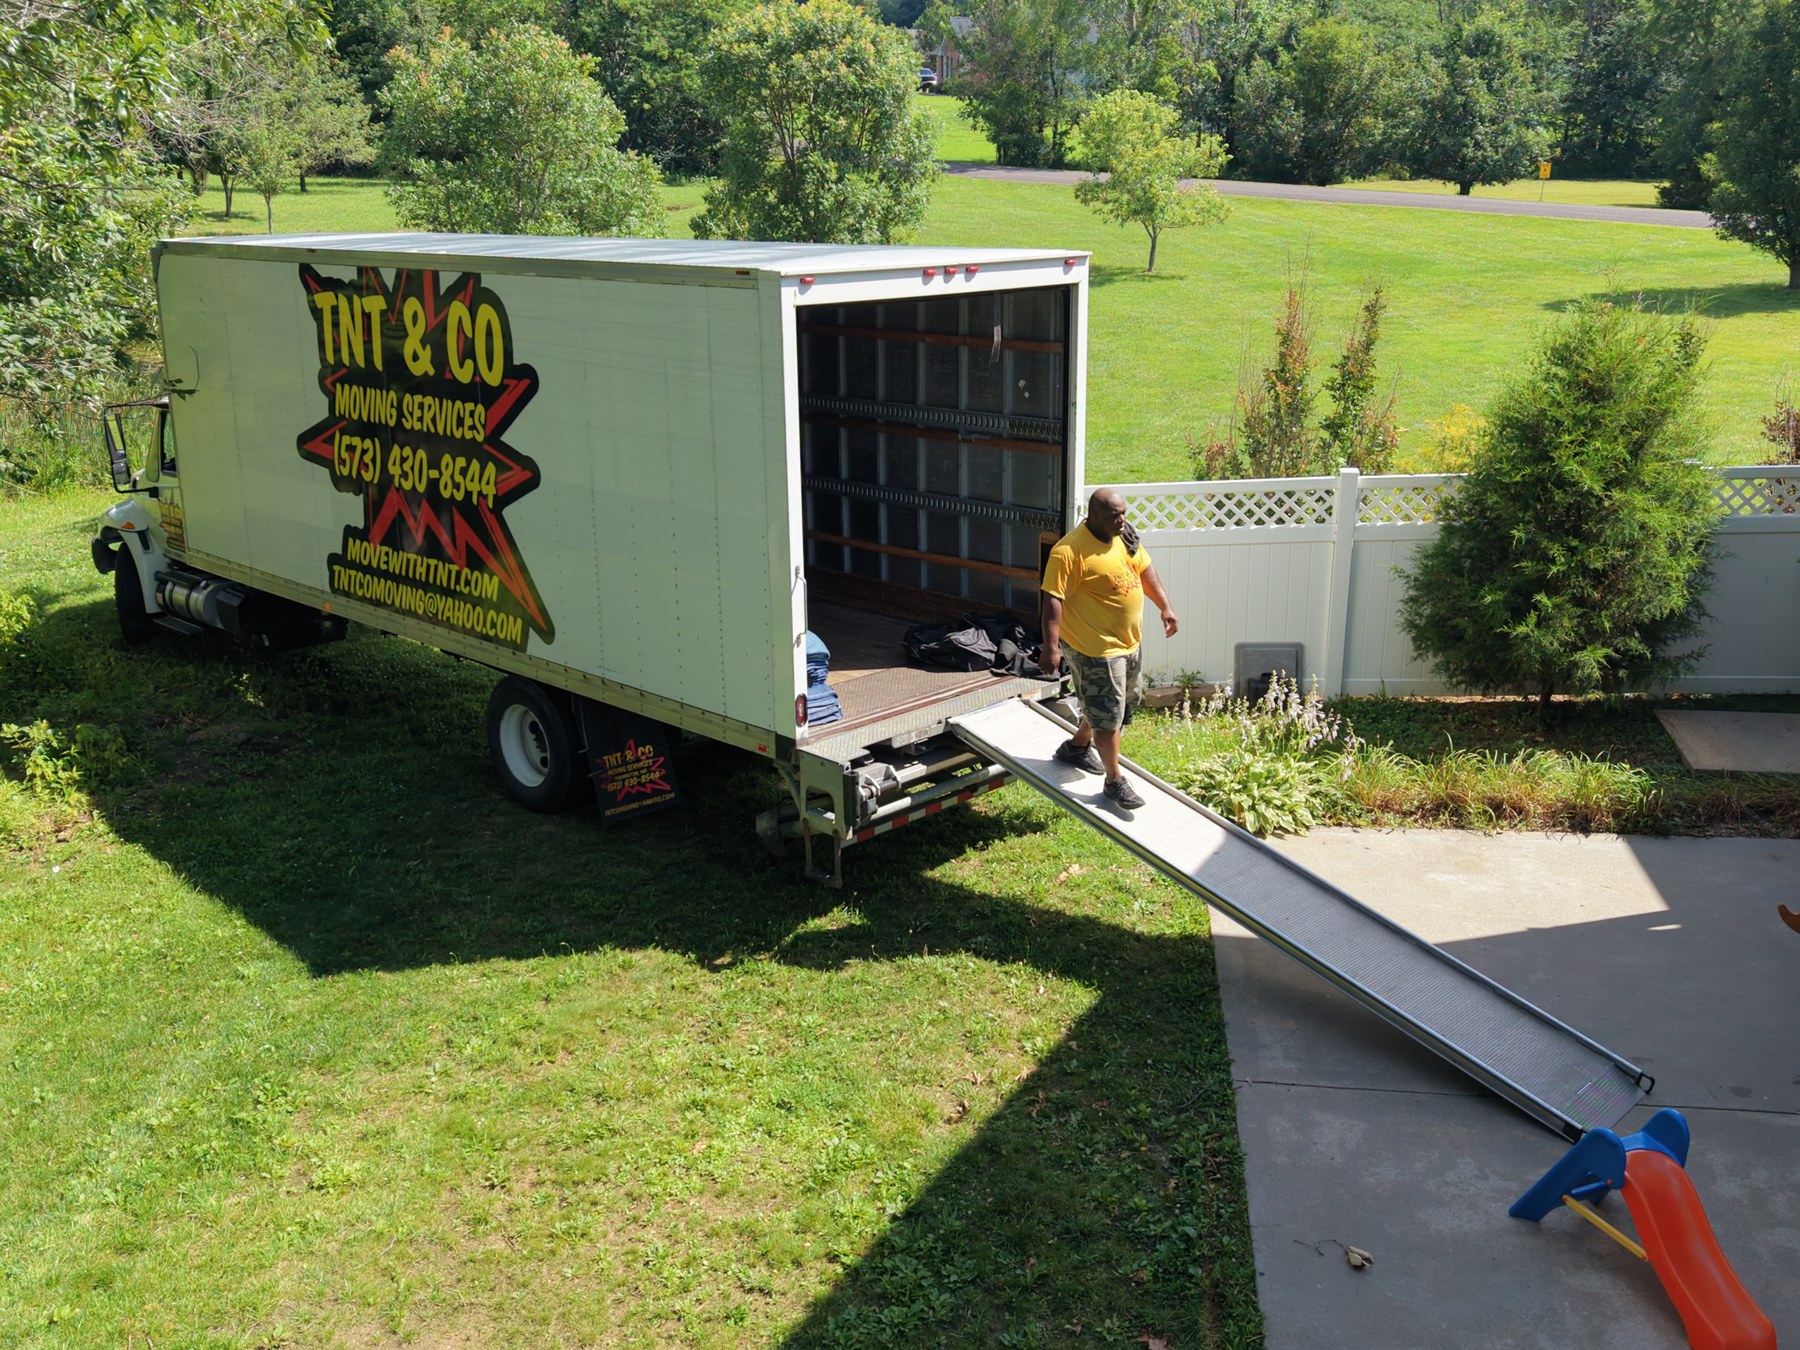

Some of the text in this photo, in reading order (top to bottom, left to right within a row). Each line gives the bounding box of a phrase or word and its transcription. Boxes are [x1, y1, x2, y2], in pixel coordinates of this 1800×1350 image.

[314, 291, 504, 387] TNT & CO
[335, 382, 486, 442] MOVING SERVICES
[334, 429, 497, 509] (573) 430-8544
[332, 565, 523, 644] TNTCOMOVING@YAHOO.COM
[347, 537, 499, 602] MOVEWITHTNT.COM
[603, 744, 654, 768] TNT & CO
